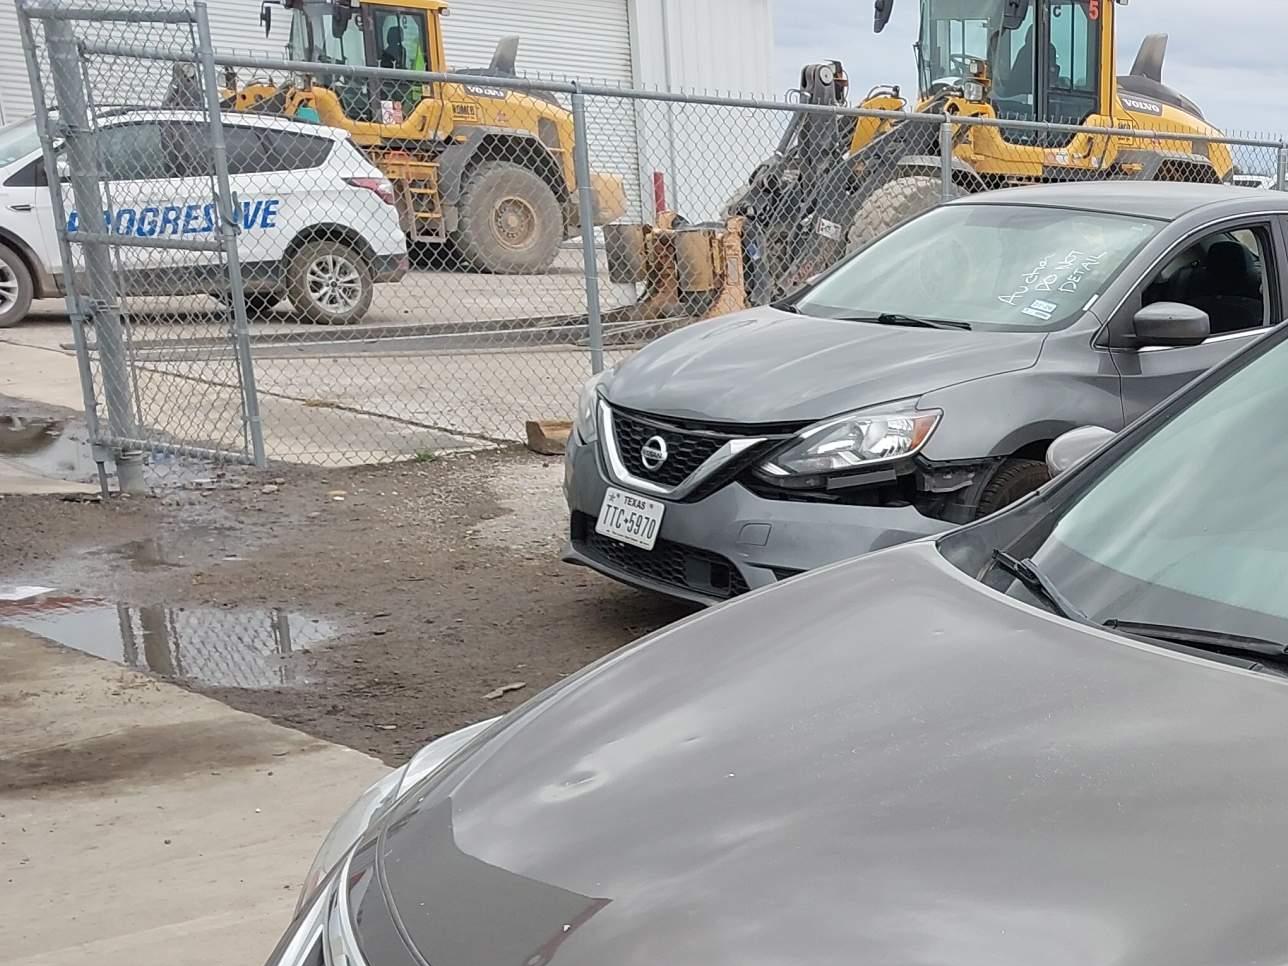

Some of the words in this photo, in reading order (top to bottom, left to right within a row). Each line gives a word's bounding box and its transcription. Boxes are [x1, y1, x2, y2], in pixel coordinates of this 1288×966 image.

[1089, 0, 1099, 20] 5
[1122, 98, 1160, 113] VOLVO
[67, 200, 279, 238] POGRESIVE
[1058, 251, 1108, 293] DETAIL
[624, 496, 646, 510] TEXAS
